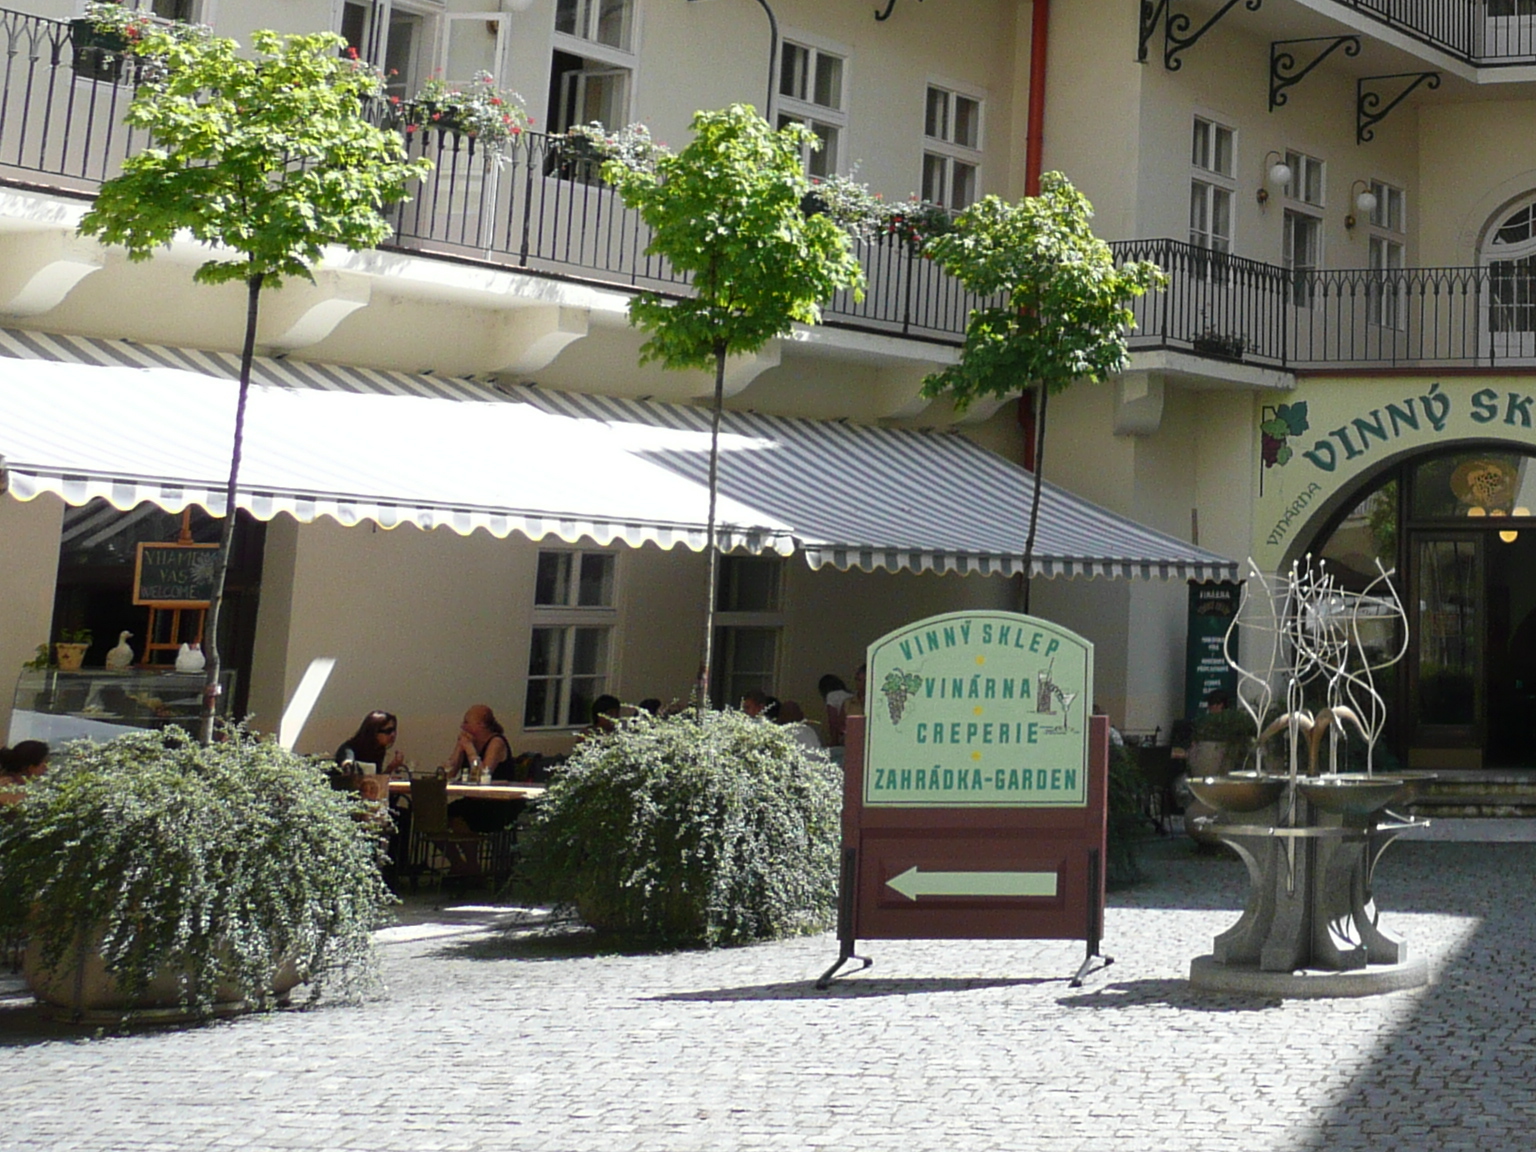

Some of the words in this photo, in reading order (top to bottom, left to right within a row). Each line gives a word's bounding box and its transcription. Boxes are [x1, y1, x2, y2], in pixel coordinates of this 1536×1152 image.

[1303, 383, 1451, 472] VINNÝ
[1266, 482, 1322, 546] VINÁRNA
[899, 620, 972, 661] VINNÝ
[982, 624, 1060, 657] SKLEP
[925, 674, 1031, 699] VINÁRNA
[917, 722, 1039, 744] CREPERIE
[875, 764, 1077, 790] ZAHRÁDKA-GARDEN
